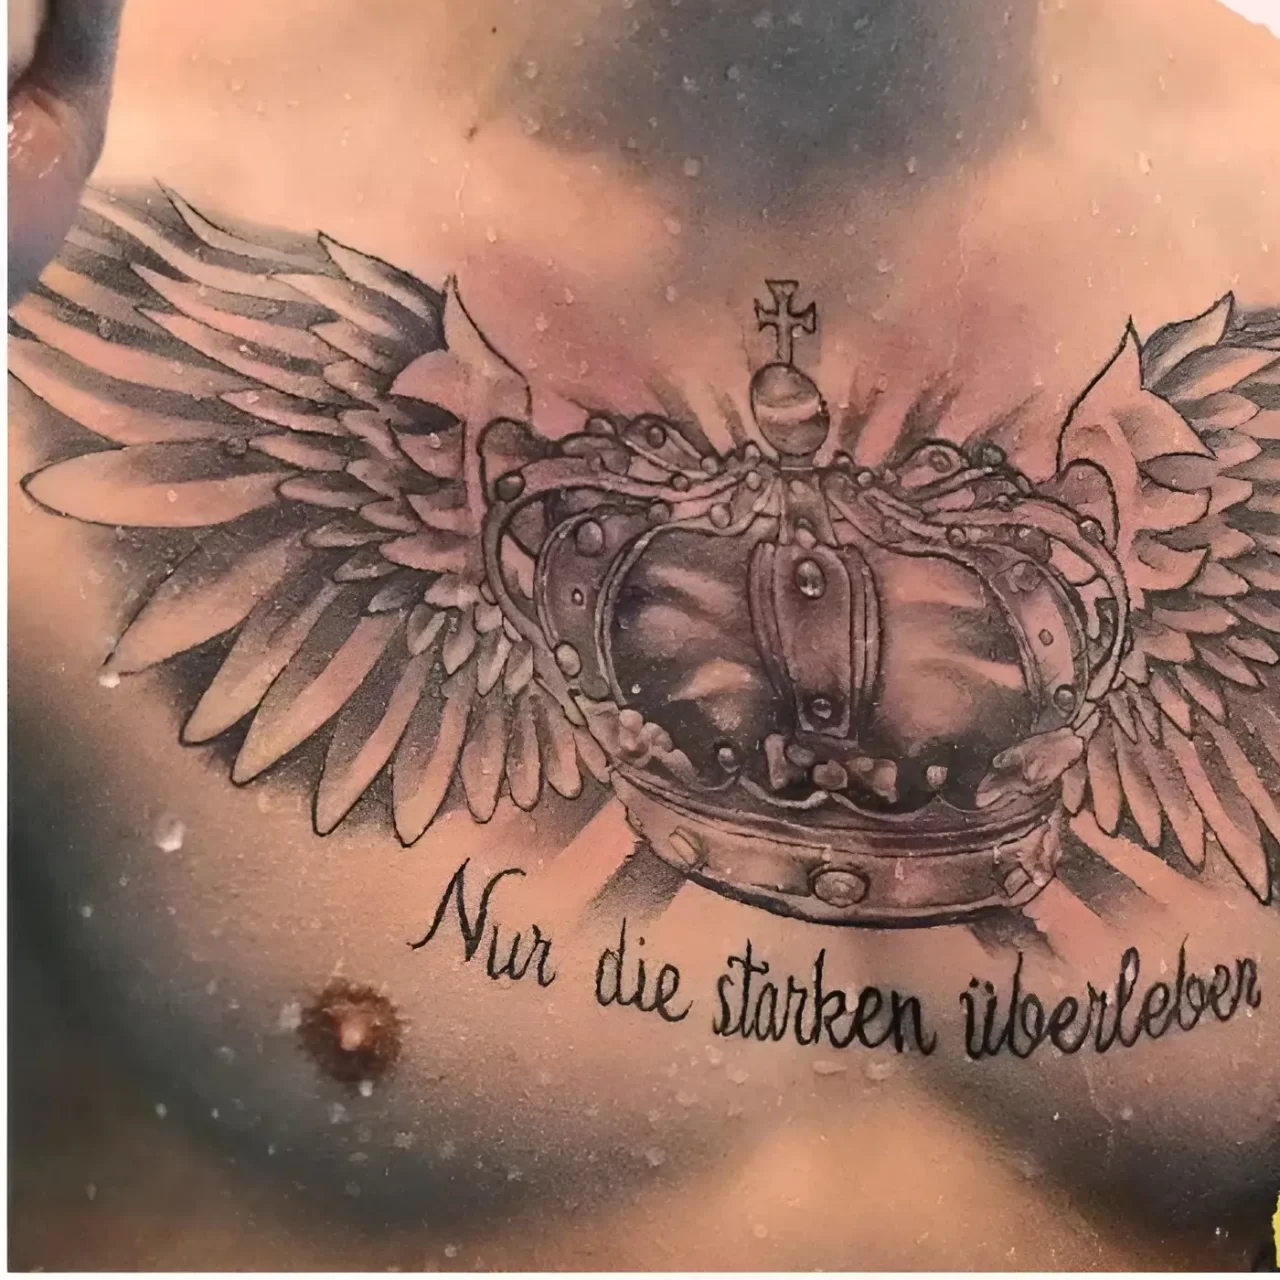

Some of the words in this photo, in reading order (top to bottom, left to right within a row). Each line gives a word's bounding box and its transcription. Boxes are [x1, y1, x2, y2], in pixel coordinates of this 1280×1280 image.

[408, 857, 556, 988] Nur
[595, 918, 693, 1023] die
[711, 939, 938, 1057] starken
[960, 933, 1263, 1060] überleben
